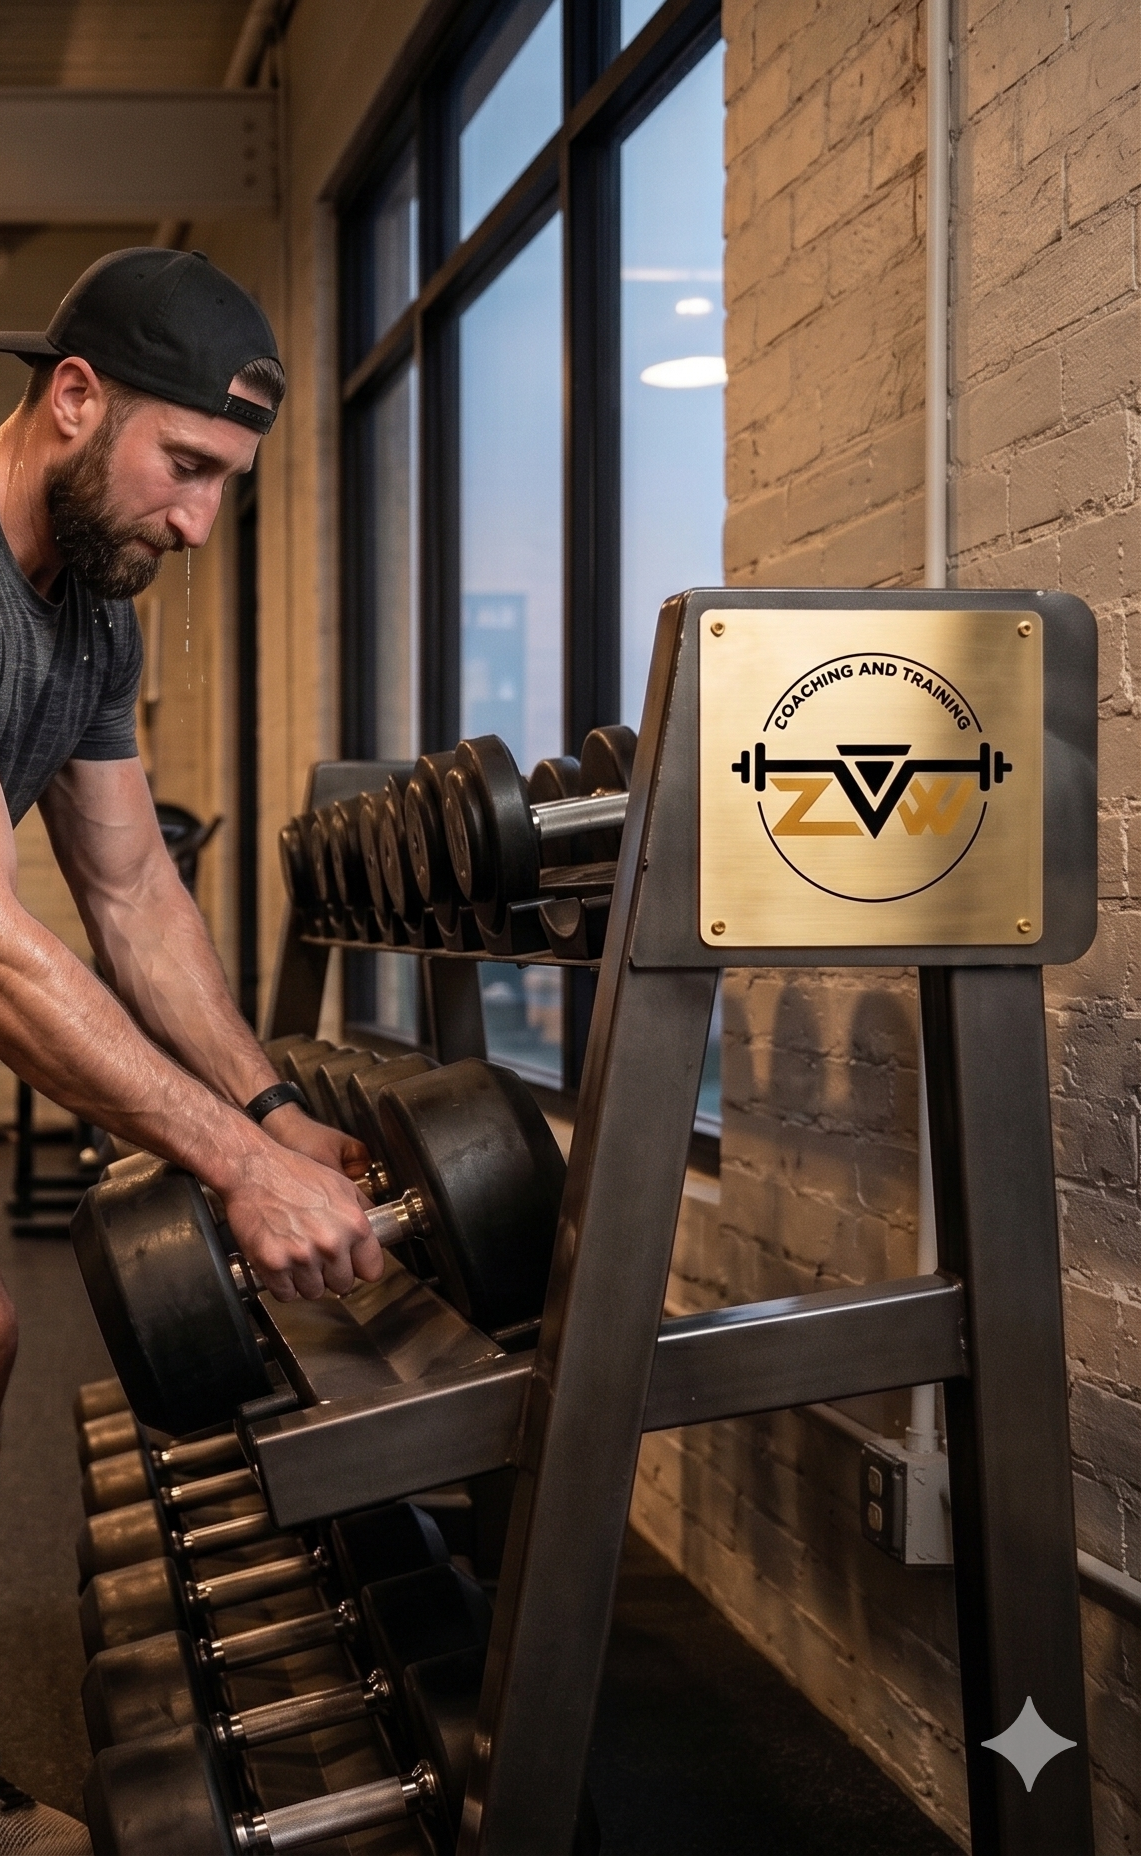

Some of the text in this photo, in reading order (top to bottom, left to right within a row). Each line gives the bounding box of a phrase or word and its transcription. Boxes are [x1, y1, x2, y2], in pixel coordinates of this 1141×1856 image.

[774, 662, 971, 730] COACHING AND TRAINING
